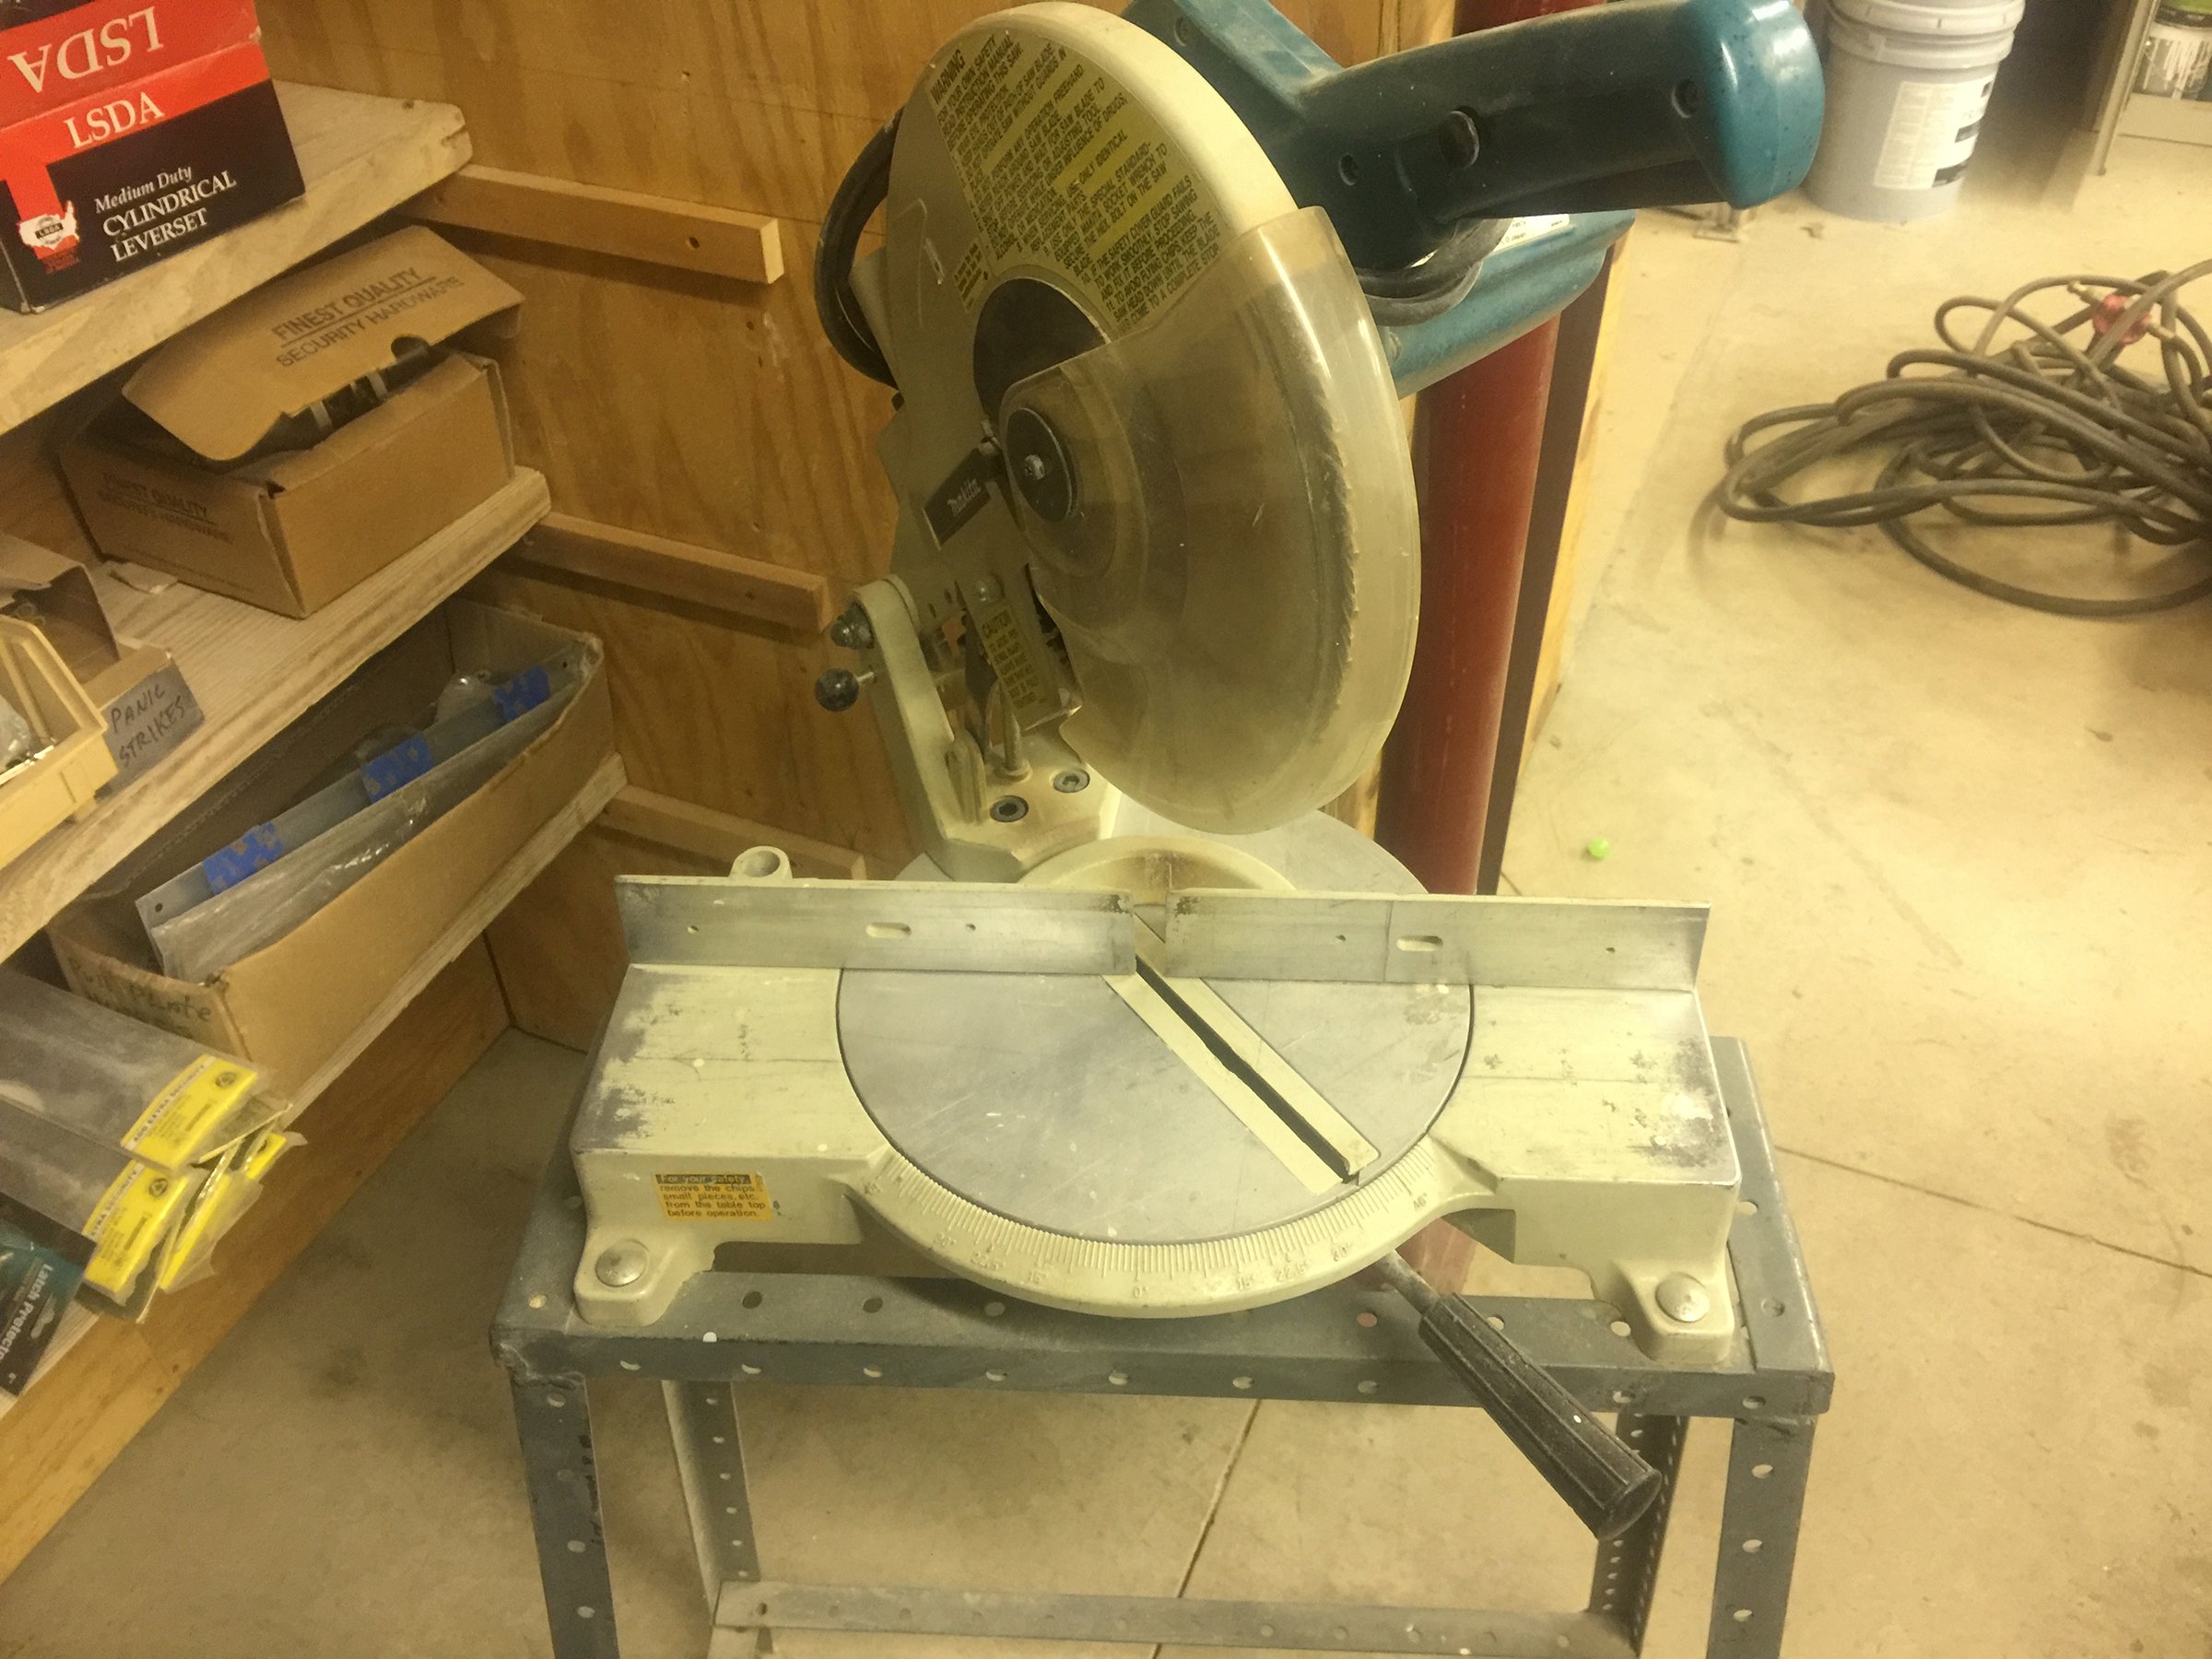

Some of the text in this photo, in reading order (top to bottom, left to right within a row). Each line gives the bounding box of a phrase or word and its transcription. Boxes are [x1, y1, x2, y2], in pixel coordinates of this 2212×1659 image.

[7, 6, 163, 93] LSDA
[929, 47, 966, 105] WARNING
[65, 92, 165, 147] LSDA
[1154, 141, 1169, 159] TO
[94, 166, 193, 214] Medium Duty
[102, 170, 237, 237] CYLINDRICAL
[1108, 201, 1128, 223] BOLT
[1124, 190, 1139, 206] ON
[1135, 176, 1152, 195] THE
[1149, 160, 1170, 182] SAW
[110, 207, 207, 262] LEVERSET
[272, 266, 423, 340] FINEST QUALITY
[276, 319, 366, 368] SECURITY
[111, 684, 166, 735] PANIC
[119, 695, 185, 768] STRIKES
[667, 1208, 702, 1217] before
[747, 1201, 766, 1210] top
[28, 1264, 53, 1300] Latch
